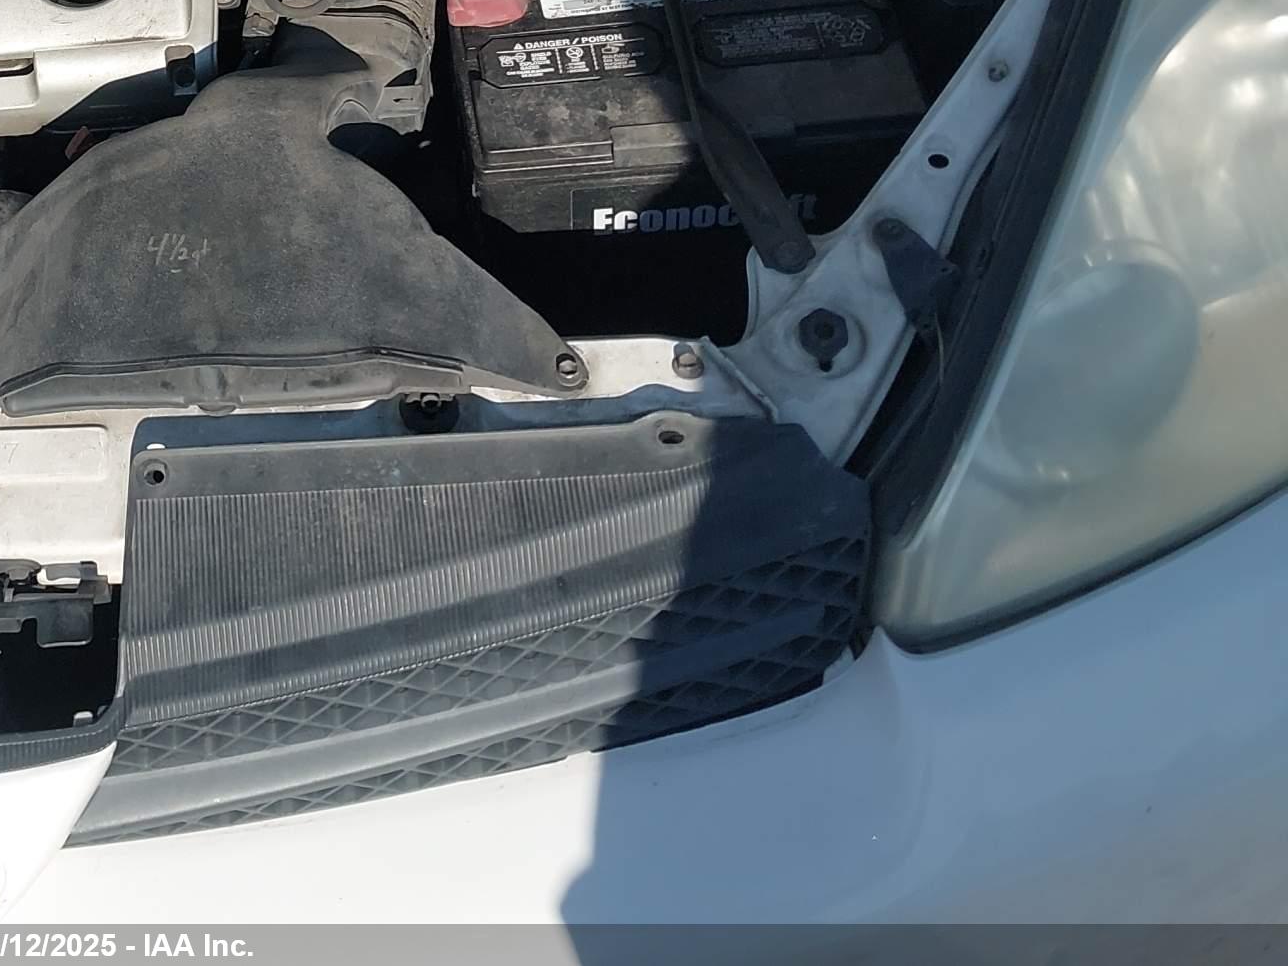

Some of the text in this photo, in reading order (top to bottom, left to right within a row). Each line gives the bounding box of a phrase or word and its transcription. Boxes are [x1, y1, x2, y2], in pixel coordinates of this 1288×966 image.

[524, 39, 571, 49] DANGER
[581, 34, 623, 44] POISON
[593, 193, 818, 235] Econocft
